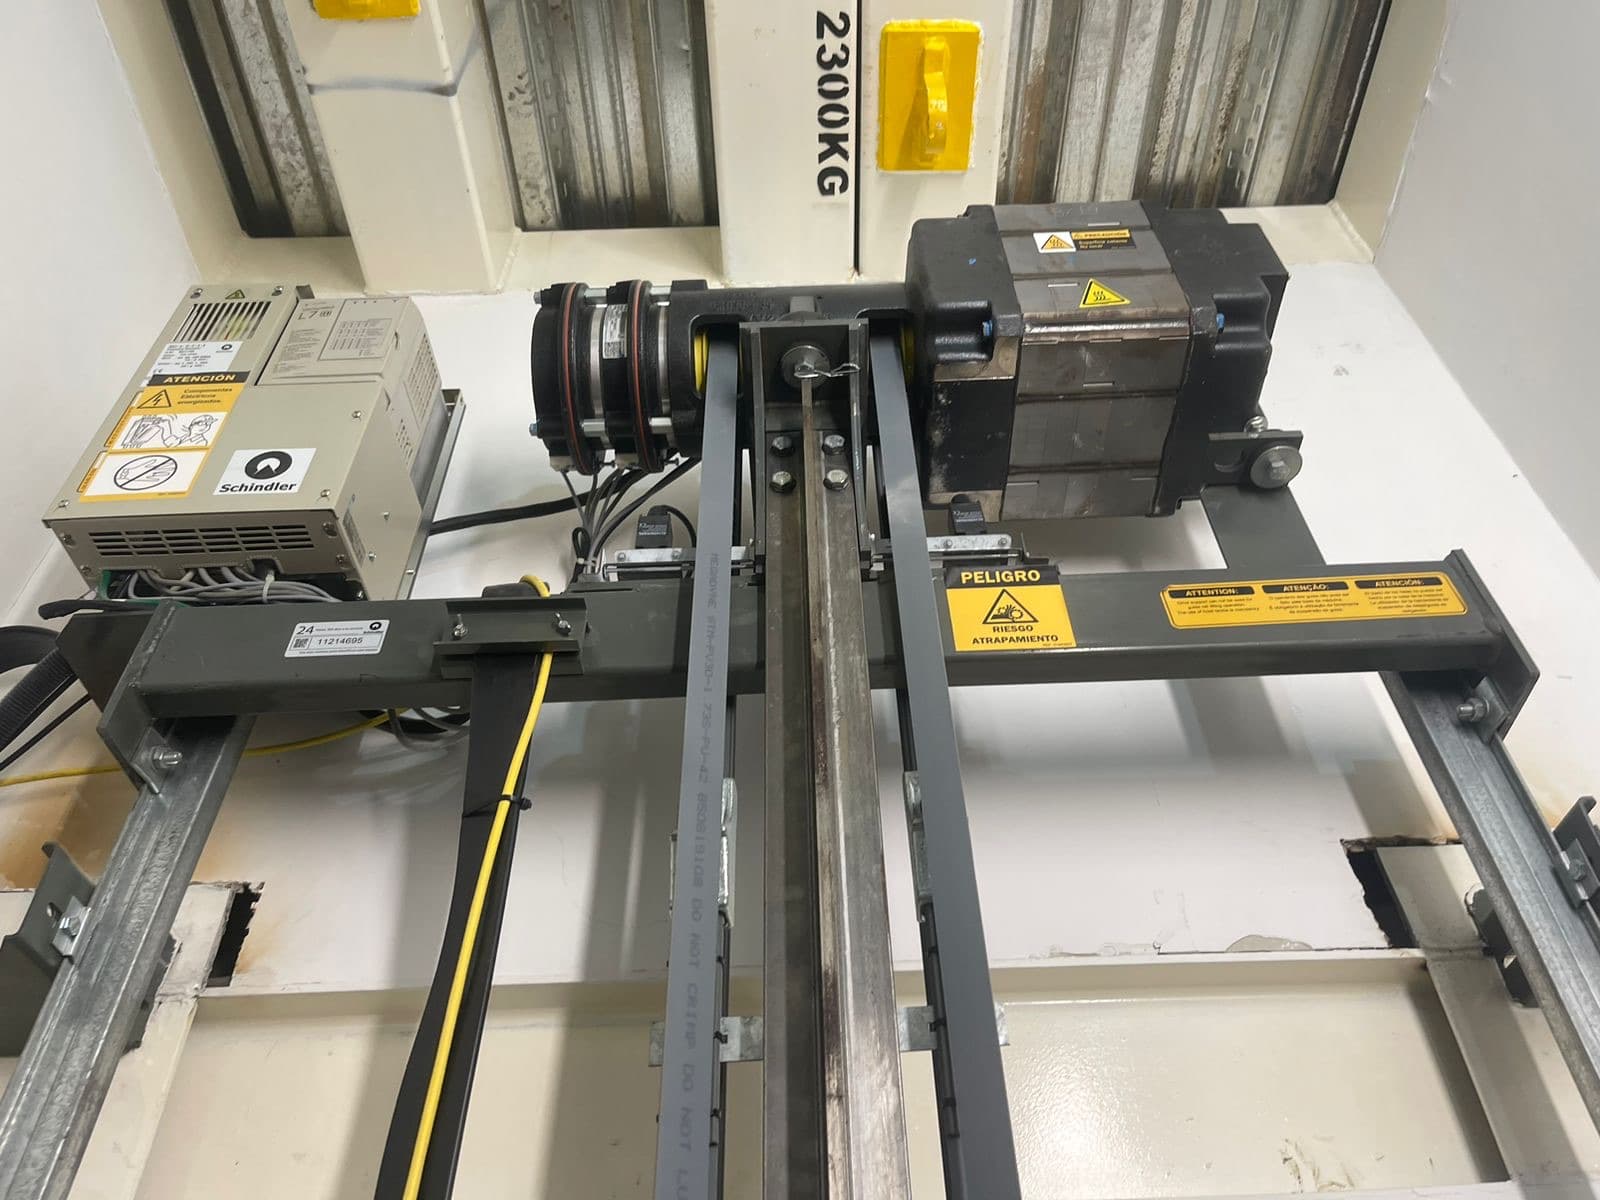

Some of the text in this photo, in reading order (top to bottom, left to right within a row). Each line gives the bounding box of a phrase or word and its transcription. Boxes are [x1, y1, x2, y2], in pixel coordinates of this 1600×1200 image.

[816, 10, 851, 196] 2300KG
[164, 374, 236, 384] ATENCIÓN
[219, 482, 297, 493] Schindler
[961, 569, 1041, 584] PELIGRO
[296, 625, 315, 635] 24
[992, 624, 1034, 633] RIESGO
[972, 634, 1059, 645] ATRAPAMIENTO
